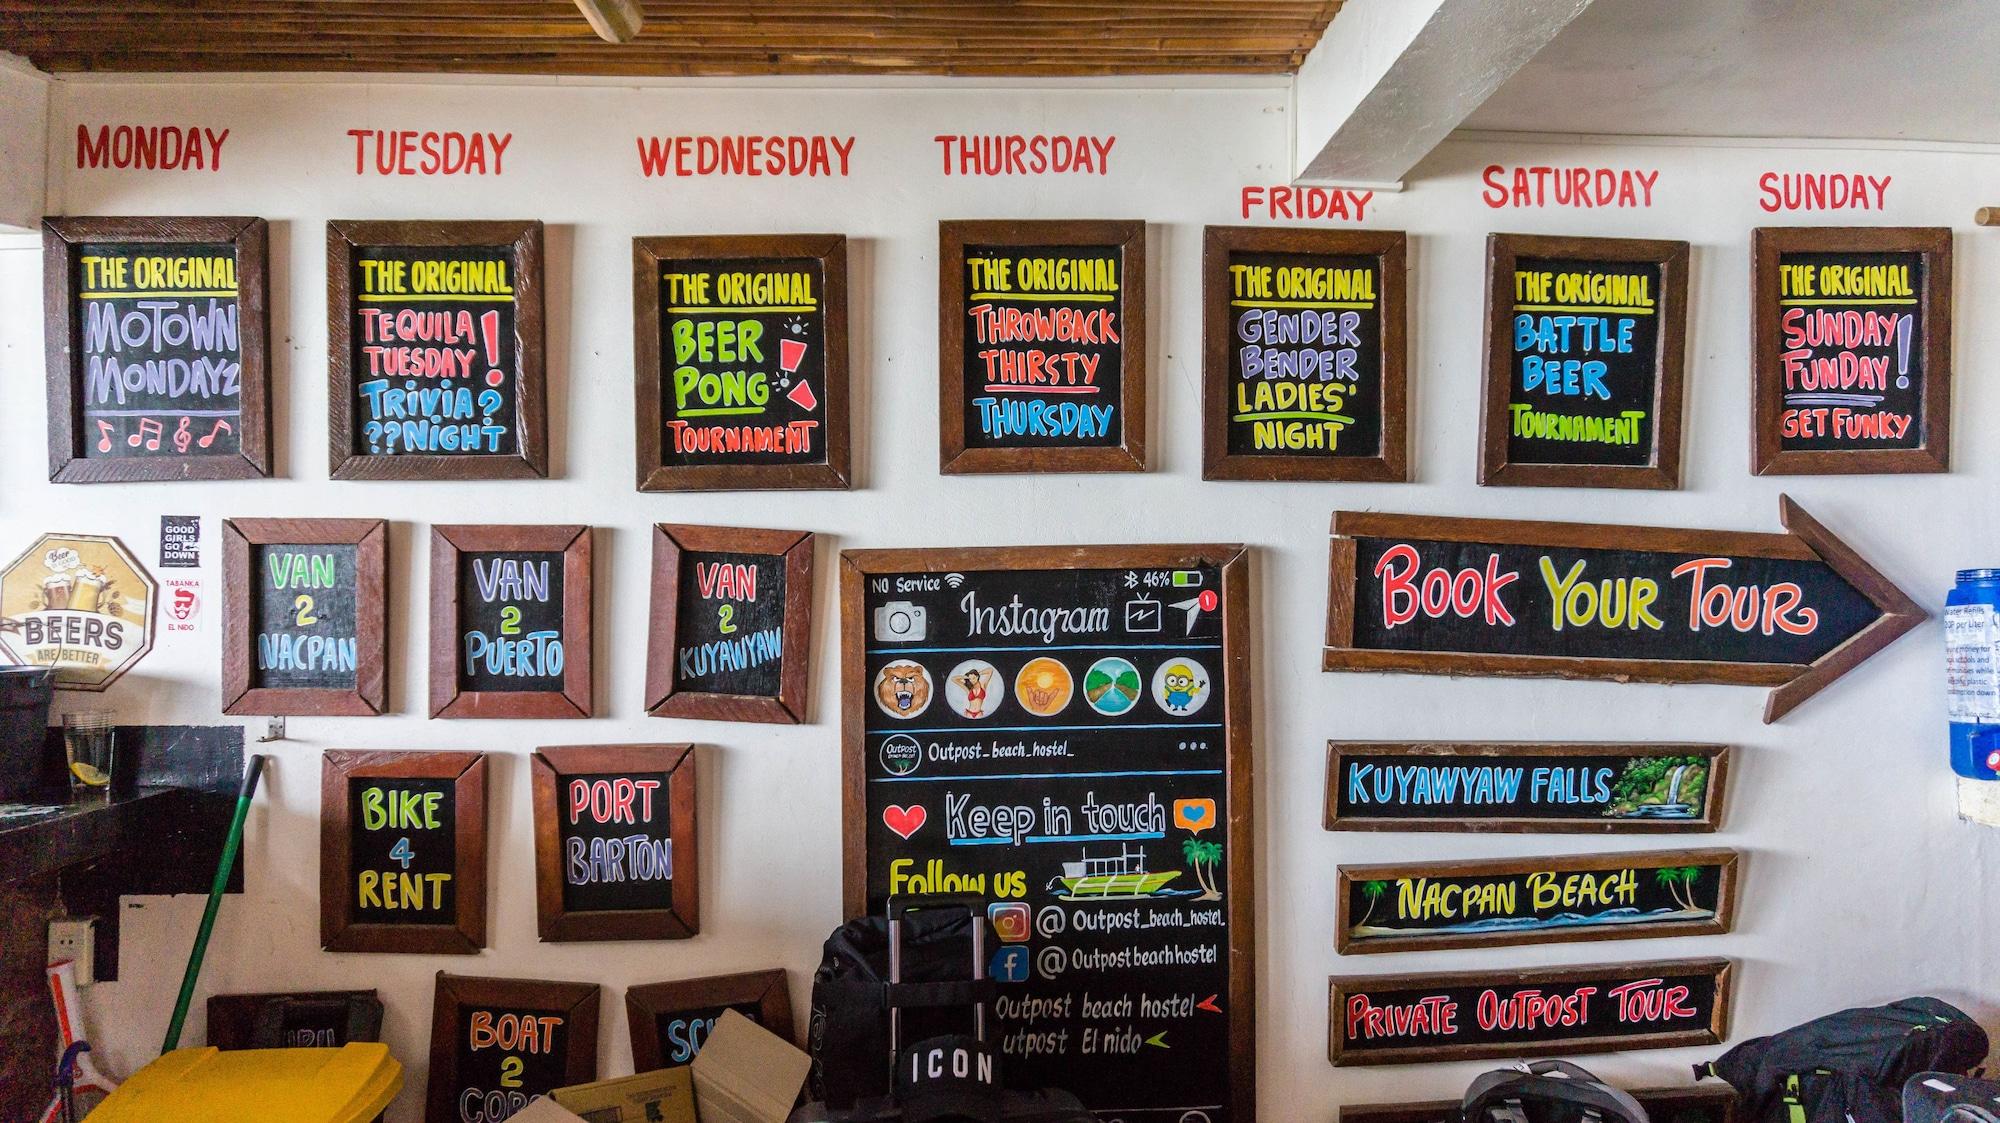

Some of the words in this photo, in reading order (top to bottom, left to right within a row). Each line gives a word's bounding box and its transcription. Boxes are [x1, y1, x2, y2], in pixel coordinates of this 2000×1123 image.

[76, 124, 230, 171] MONDAY
[347, 129, 512, 175] TUESDAY
[636, 135, 855, 176] WEDNESDAY
[934, 134, 1116, 175] THURSDAY
[1242, 186, 1373, 222] FRIDAY
[1482, 164, 1659, 208] SATURDAY
[1759, 172, 1892, 212] SUNDAY
[81, 257, 128, 289] THE
[134, 257, 237, 289] ORIGINAL
[359, 260, 406, 293] THE
[412, 260, 513, 293] ORIGINAL
[663, 273, 710, 304] THE
[718, 272, 817, 305] ORIGINAL
[968, 258, 1011, 290] THE
[1017, 258, 1119, 291] ORIGINAL
[1229, 264, 1273, 299] THE
[1277, 267, 1376, 300] ORIGINAL
[1515, 271, 1552, 303] THE
[1556, 272, 1654, 307] ORIGINAL
[1779, 265, 1815, 296] THE
[1820, 265, 1913, 297] ORIGINAL
[86, 298, 237, 353] MOTOWN
[359, 309, 475, 345] TEQUILA
[672, 319, 764, 365] BEER
[970, 304, 1120, 344] THROWBACK
[1237, 309, 1362, 347] GENDER
[1514, 314, 1635, 354] BATTLE
[1782, 308, 1898, 349] SUNDAY
[362, 346, 475, 378] TUESDAY
[978, 349, 1100, 384] THIRSTY
[1239, 345, 1359, 382] BENDER
[1522, 355, 1611, 400] BEER
[1780, 349, 1889, 391] FUNDAY
[673, 366, 769, 409] PONG
[973, 397, 1114, 438] THURSDAY
[1254, 421, 1344, 451] NIGHT
[1509, 403, 1646, 444] TOURNAMENT
[1781, 408, 1829, 438] GET
[1832, 408, 1912, 439] FUNKY
[666, 420, 818, 454] TOURNAMENT
[164, 551, 195, 559] DOWN
[165, 543, 180, 551] GO
[269, 553, 335, 589] VAN
[473, 558, 549, 602] VAN
[697, 562, 757, 601] VAN
[872, 577, 889, 594] NO
[896, 576, 941, 593] Service
[1142, 571, 1170, 587] 46%
[1373, 543, 1519, 629] BOOK
[1539, 555, 1664, 630] YOUR
[1671, 557, 1818, 635] TOUR
[295, 595, 317, 626] 2
[500, 606, 521, 635] 2
[719, 604, 736, 634] 2
[960, 590, 1110, 643] Instagram
[25, 616, 124, 650] BEERS
[37, 648, 56, 660] ARE
[62, 649, 100, 664] BETTER
[258, 633, 356, 672] NACPAN
[465, 631, 563, 677] PUERTO
[680, 627, 782, 680] KUYAWYAW
[886, 743, 917, 754] Outpost
[569, 778, 660, 825] PORT
[1348, 762, 1520, 804] KUYAWYAW
[1530, 765, 1615, 804] FALLS
[362, 787, 444, 830] BIKE
[946, 791, 1036, 845] Keep
[1043, 798, 1072, 834] in
[1082, 791, 1165, 833] touch
[389, 837, 415, 868] 4
[567, 833, 672, 886] BARTON
[358, 870, 452, 910] RENT
[890, 859, 985, 895] Follow
[994, 870, 1027, 898] us
[1396, 877, 1517, 921] NACPAN
[1526, 868, 1639, 913] BEACH
[1036, 905, 1066, 938] @
[1037, 946, 1067, 979] @
[995, 993, 1072, 1025] Outpost
[1082, 992, 1132, 1019] beach
[1141, 993, 1195, 1018] hostel
[1347, 992, 1458, 1039] PRIVATE
[1477, 986, 1597, 1031] OUTPOST
[1609, 978, 1697, 1023] TOUR
[470, 1011, 564, 1054] BOAT
[1003, 1027, 1069, 1059] utpost
[1082, 1028, 1098, 1054] El
[1104, 1025, 1142, 1054] nido
[501, 1056, 524, 1088] 2
[912, 1047, 993, 1084] ICON
